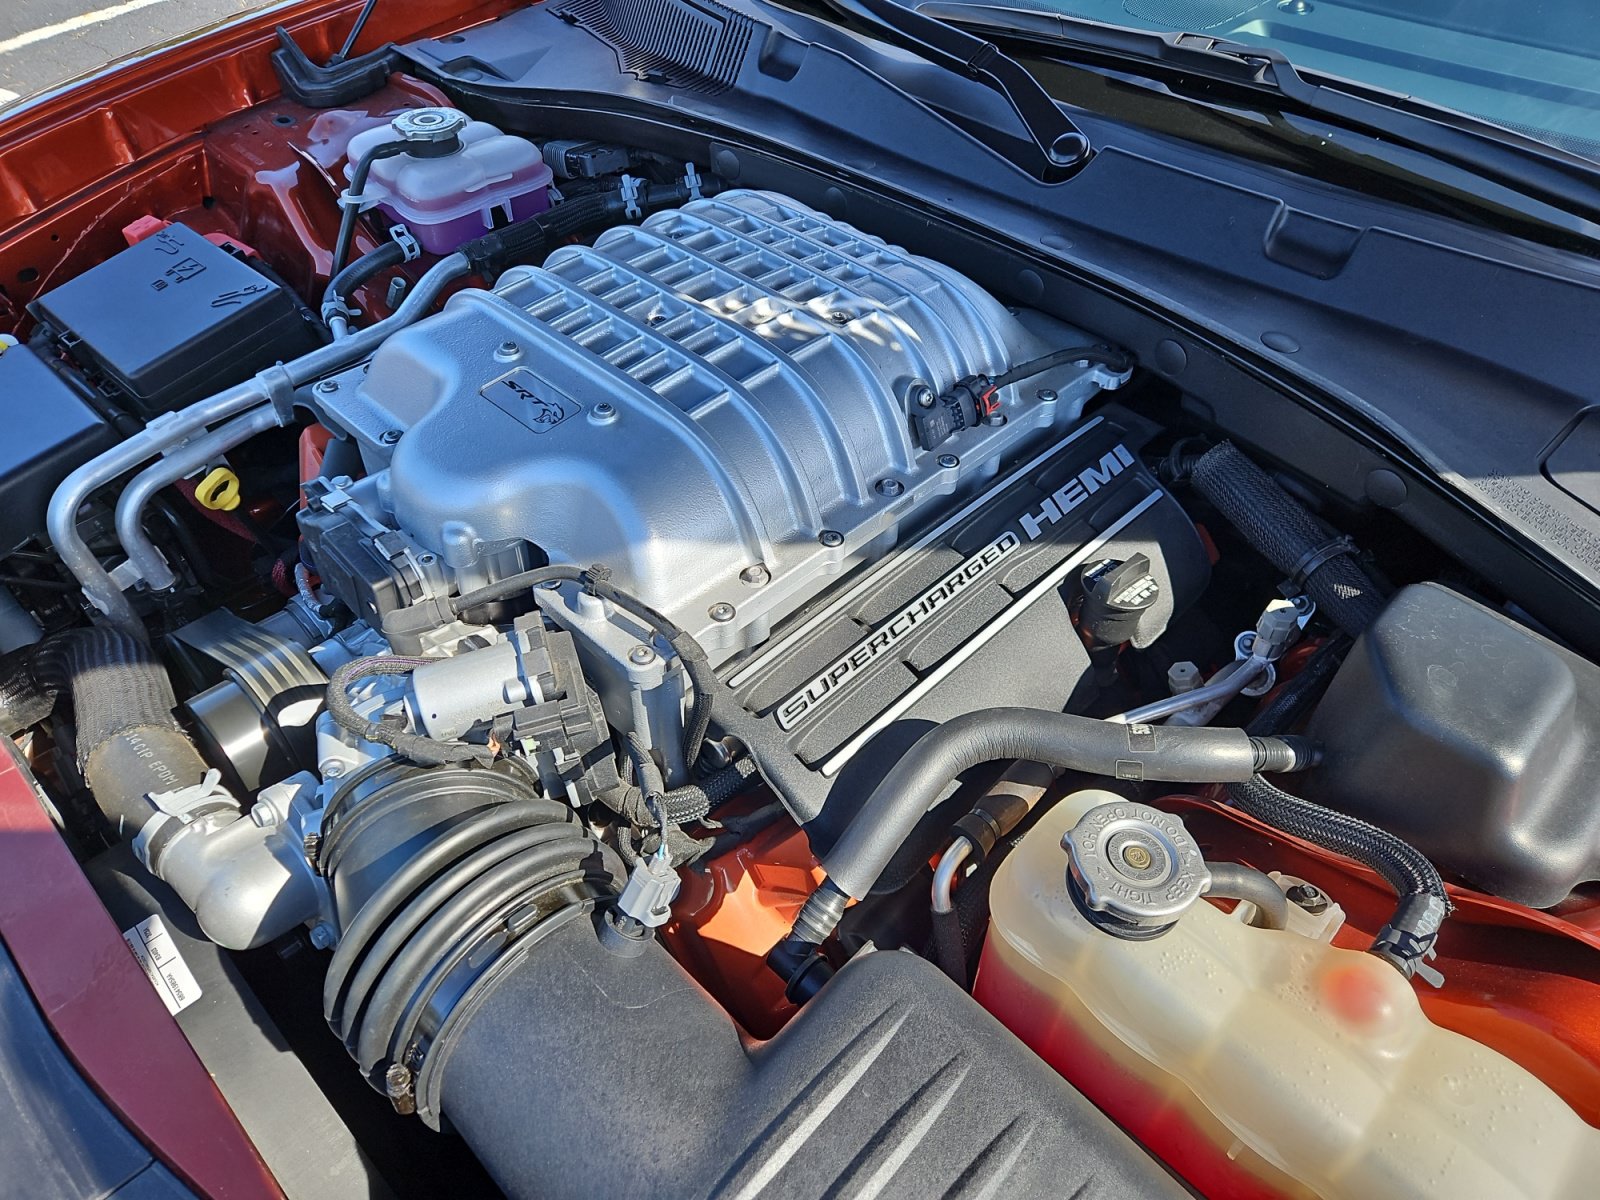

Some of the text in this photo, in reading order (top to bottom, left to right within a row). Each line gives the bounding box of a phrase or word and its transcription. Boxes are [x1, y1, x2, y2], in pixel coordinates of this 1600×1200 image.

[501, 380, 549, 407] SRT
[782, 443, 1135, 725] SUPERCHARGED HEMI
[148, 761, 179, 785] EPDM
[1089, 808, 1126, 832] OPEN
[1132, 808, 1165, 828] NOT
[1166, 826, 1188, 846] DO
[1108, 871, 1196, 906] KEEP TIGHT
